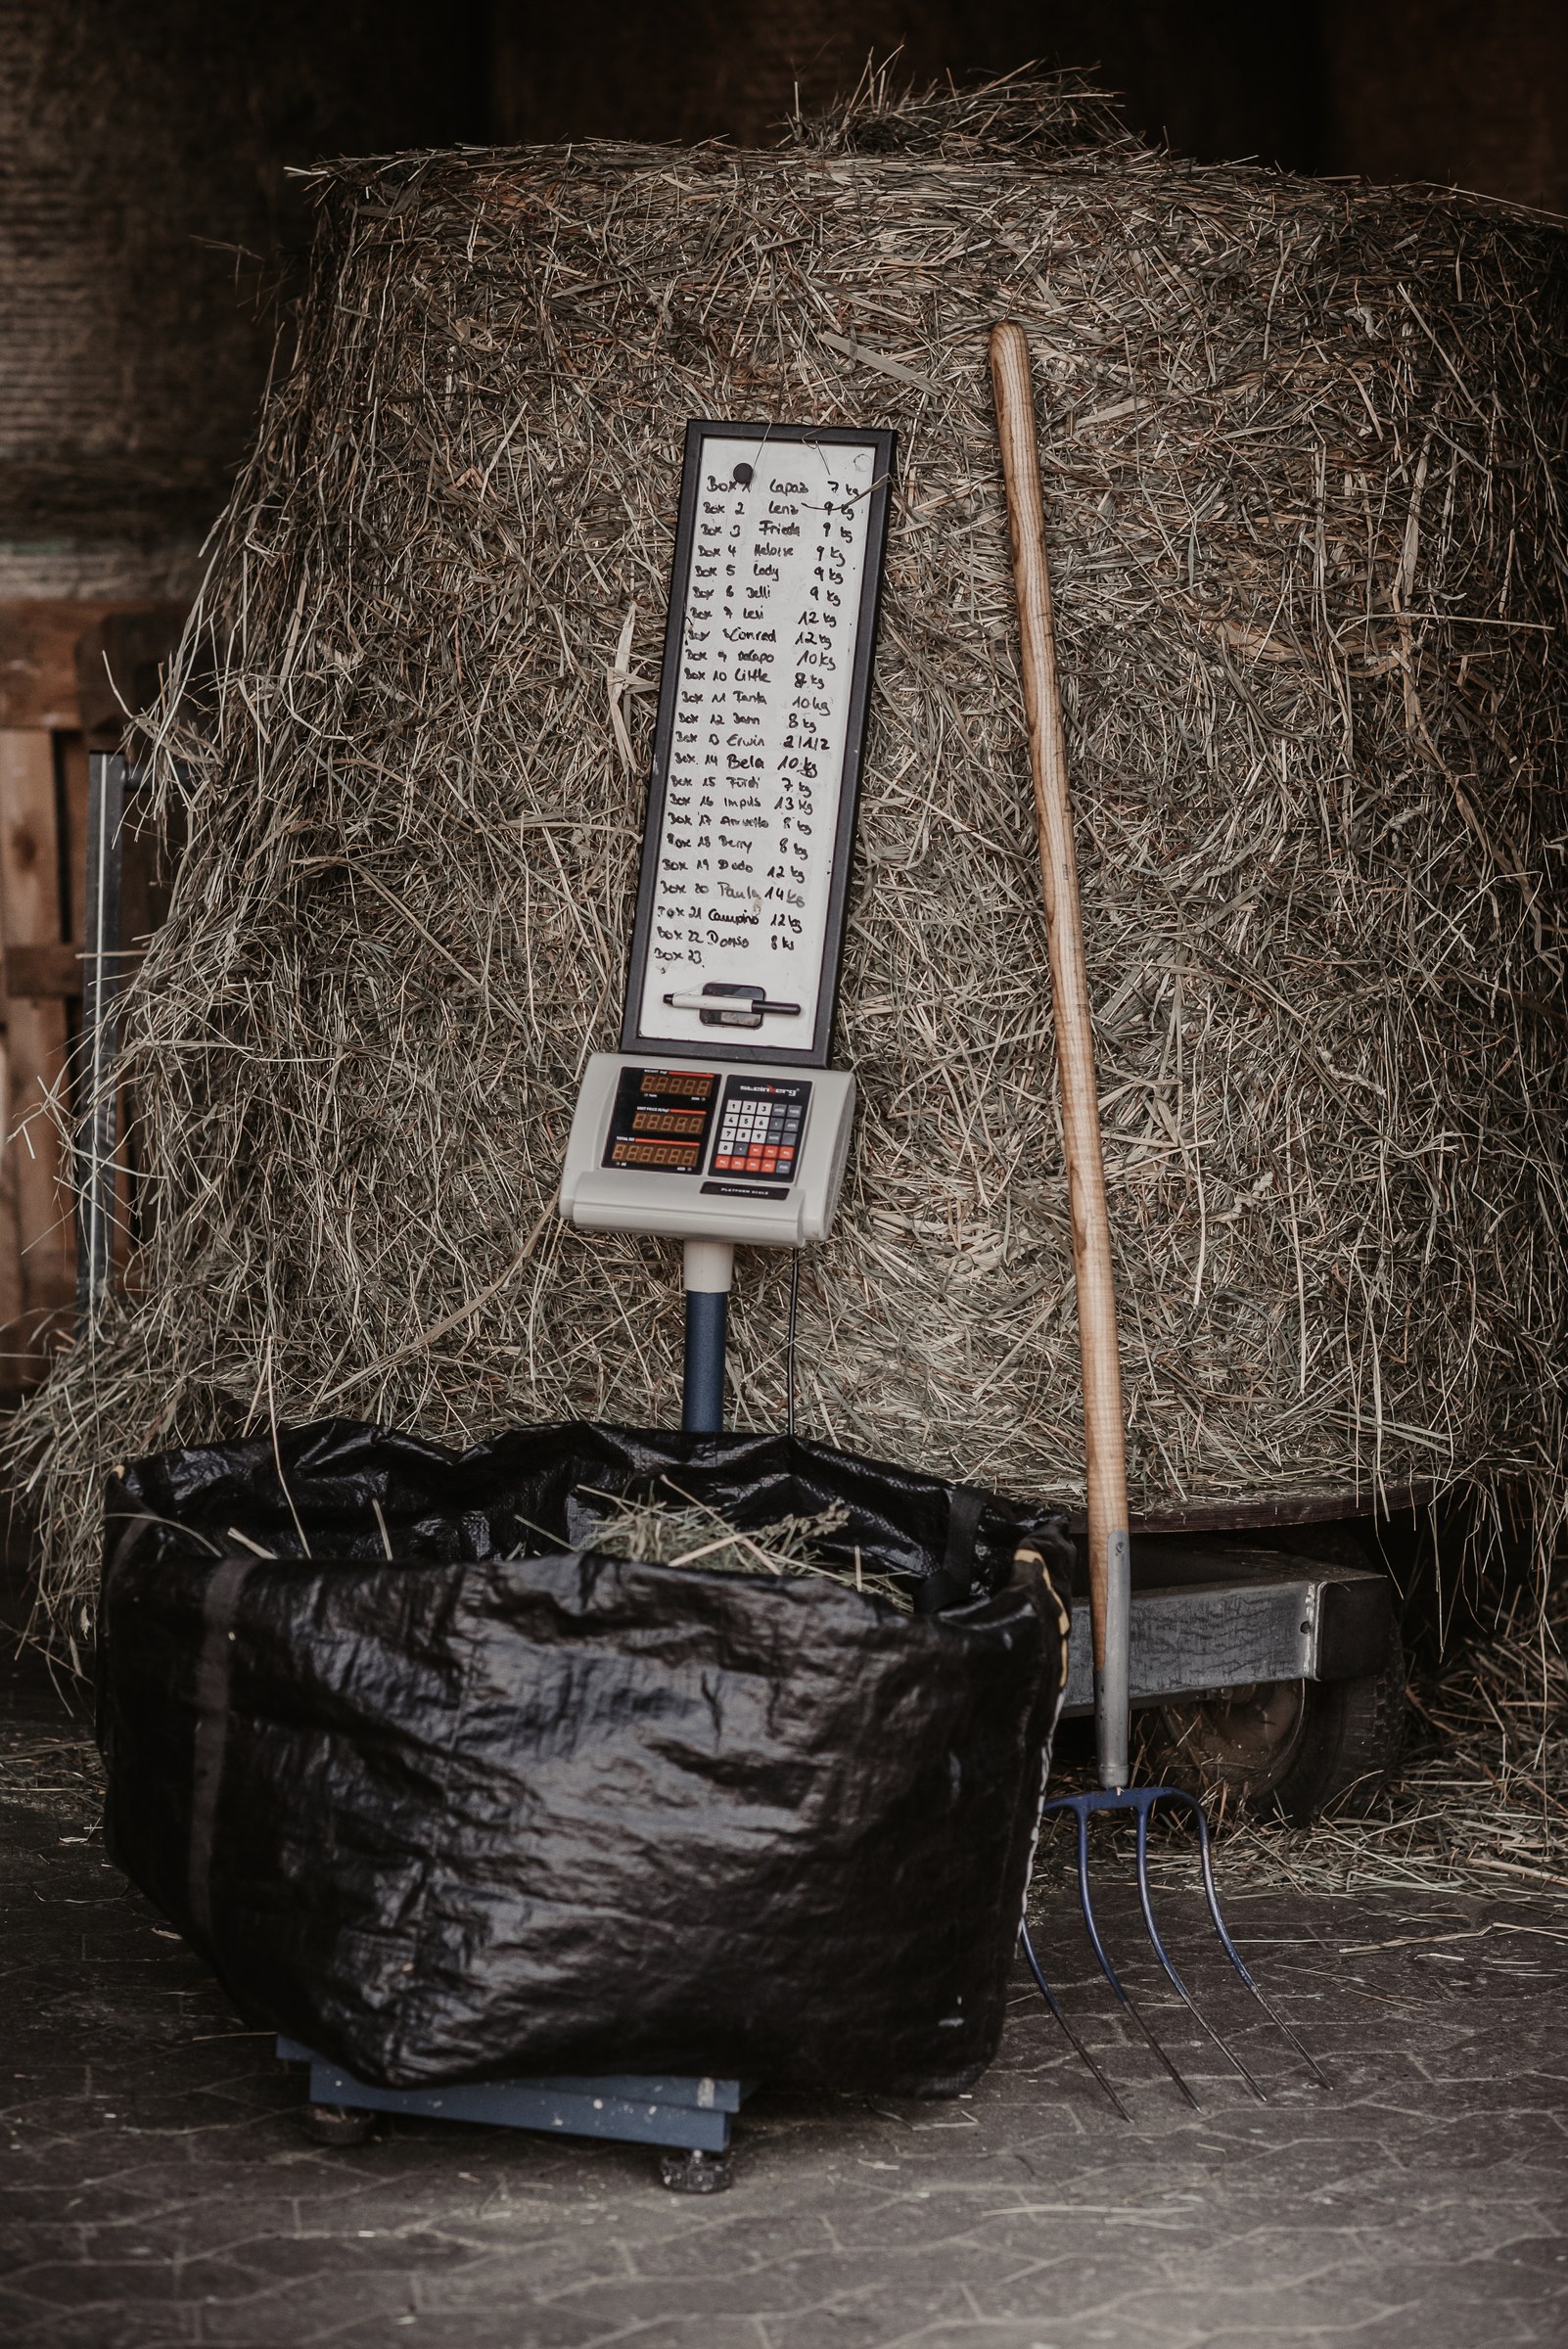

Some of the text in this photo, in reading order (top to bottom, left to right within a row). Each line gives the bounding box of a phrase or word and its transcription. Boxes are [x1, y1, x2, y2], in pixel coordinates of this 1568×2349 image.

[828, 481, 839, 493] 7
[735, 502, 745, 515] 2
[824, 501, 833, 515] 9
[701, 524, 721, 535] Box
[730, 525, 740, 537] 3
[698, 545, 720, 557] Box
[728, 545, 736, 557] 4
[816, 546, 824, 561] 9
[831, 547, 845, 567] kg
[695, 565, 716, 576] Box
[726, 565, 735, 576] 5
[814, 567, 824, 581] 9
[829, 569, 843, 584] kg
[693, 586, 714, 600] Box
[726, 585, 734, 598] 6
[810, 586, 818, 600] 9
[827, 590, 841, 607] kg
[690, 607, 713, 620] Box
[723, 606, 733, 619] 7
[798, 611, 819, 624] 12
[823, 612, 837, 627] kg
[795, 632, 817, 645] 12
[819, 634, 832, 650] kg
[685, 649, 708, 661] Box
[717, 651, 727, 662] 9
[797, 650, 817, 666] 10
[820, 652, 836, 670] kg
[684, 668, 706, 680] Box
[713, 670, 726, 681] 10
[794, 672, 807, 688] 8
[810, 674, 824, 689] kg
[682, 691, 703, 703] Box
[712, 692, 725, 703] 11
[792, 696, 809, 708] 10
[812, 697, 831, 715] kg
[678, 713, 698, 723] Box
[710, 714, 724, 725] 12
[789, 714, 799, 728] 8
[803, 718, 816, 733] kg
[675, 731, 697, 742] Box
[705, 755, 717, 766] 14
[777, 756, 799, 770] 10
[804, 757, 817, 778] kg
[670, 775, 692, 787] Box
[703, 777, 715, 787] 15
[782, 777, 793, 791] 7
[799, 782, 811, 798] kg
[669, 793, 690, 806] Box
[700, 796, 714, 806] 16
[774, 797, 794, 810] 13
[668, 812, 692, 825] Box
[699, 814, 712, 826] 17
[798, 820, 811, 835] kg
[667, 833, 691, 849] Box
[698, 836, 711, 848] 18
[780, 838, 788, 853] 8
[794, 843, 808, 860] kg
[697, 859, 709, 870] 19
[767, 866, 785, 878] 12
[791, 866, 805, 883] kg
[764, 887, 783, 900] 14
[689, 906, 702, 919] 21
[770, 914, 785, 926] 12
[788, 915, 803, 934] kg
[688, 930, 704, 944] 22
